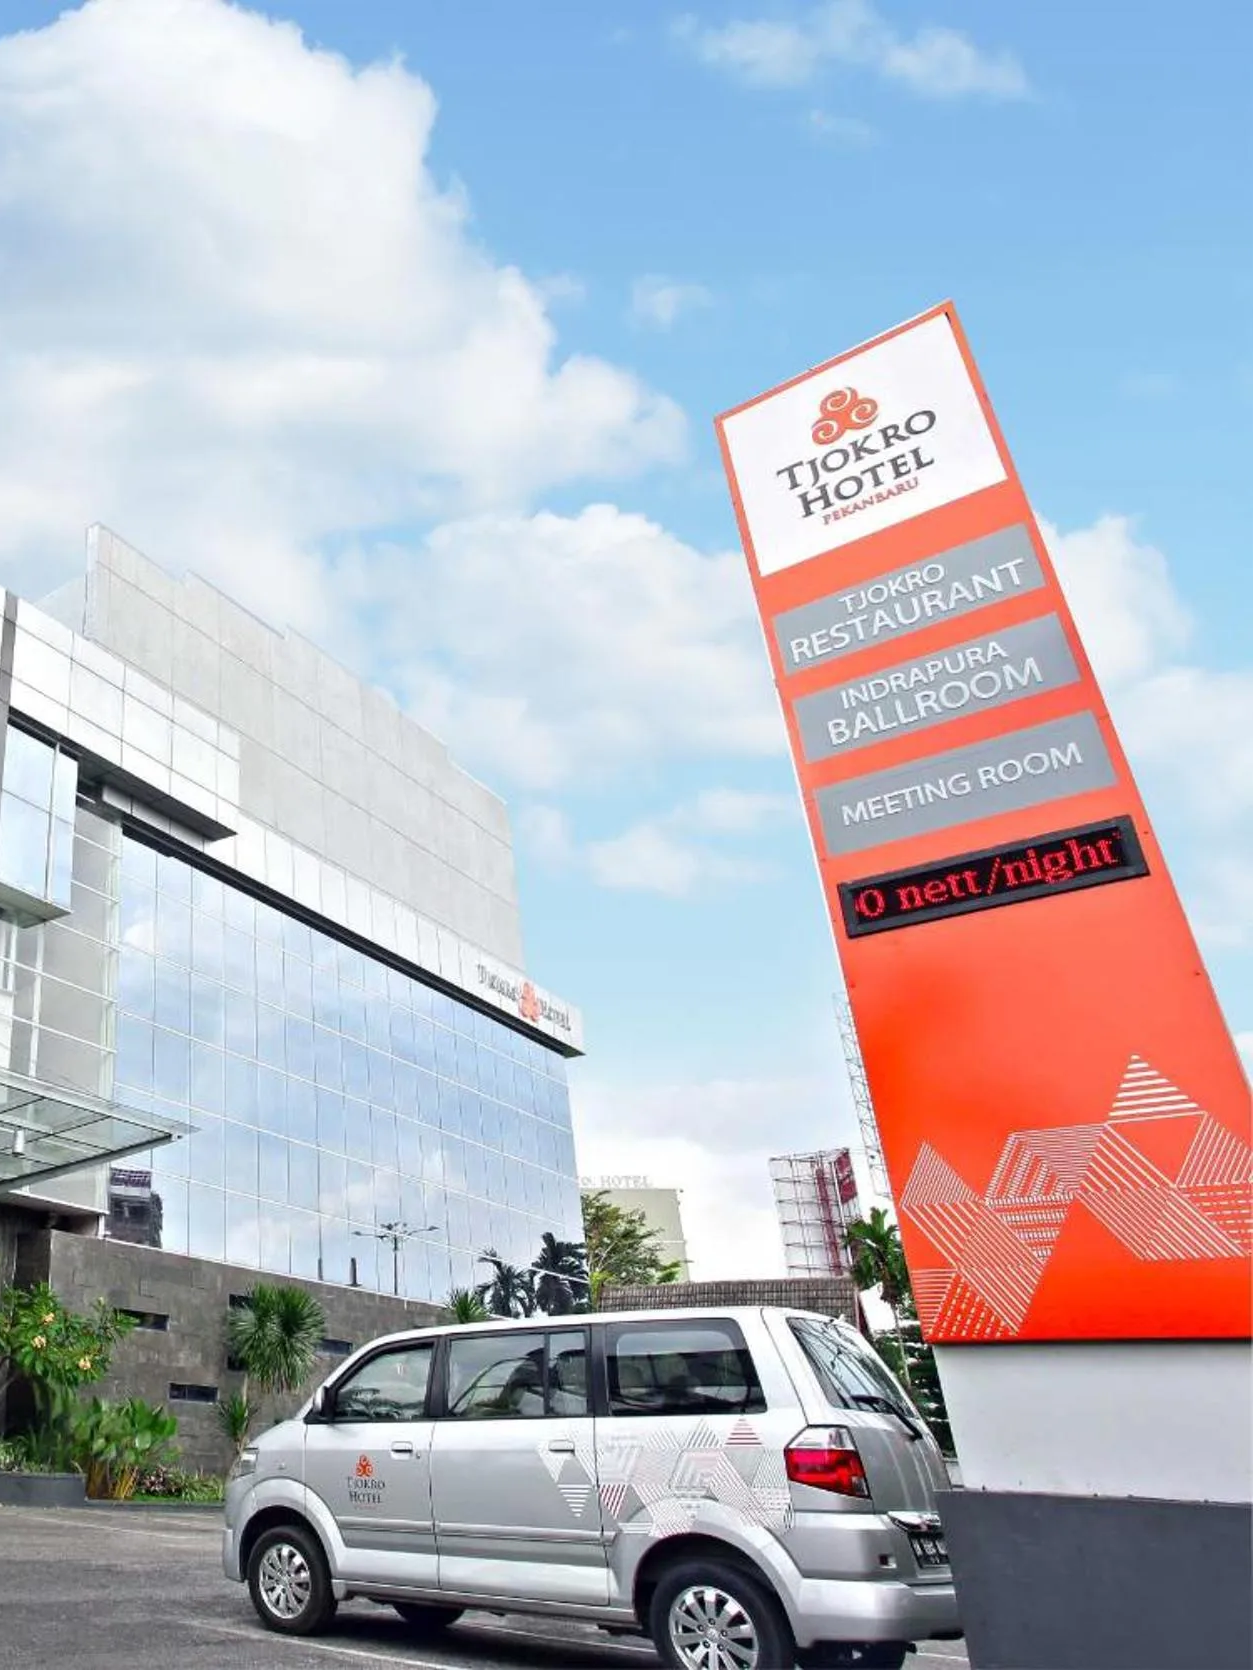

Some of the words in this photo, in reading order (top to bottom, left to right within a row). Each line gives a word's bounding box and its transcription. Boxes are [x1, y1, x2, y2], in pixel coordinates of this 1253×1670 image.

[776, 409, 937, 490] TJOKRO
[797, 446, 935, 518] HOTEL
[821, 476, 920, 526] PEKANBARU
[790, 557, 1026, 664] RESTAURANT
[839, 563, 946, 615] TJOKRO
[827, 657, 1044, 746] BALLROOM
[840, 640, 1008, 710] INDRAPURA
[840, 773, 972, 826] MEETING
[977, 741, 1084, 790] ROOM
